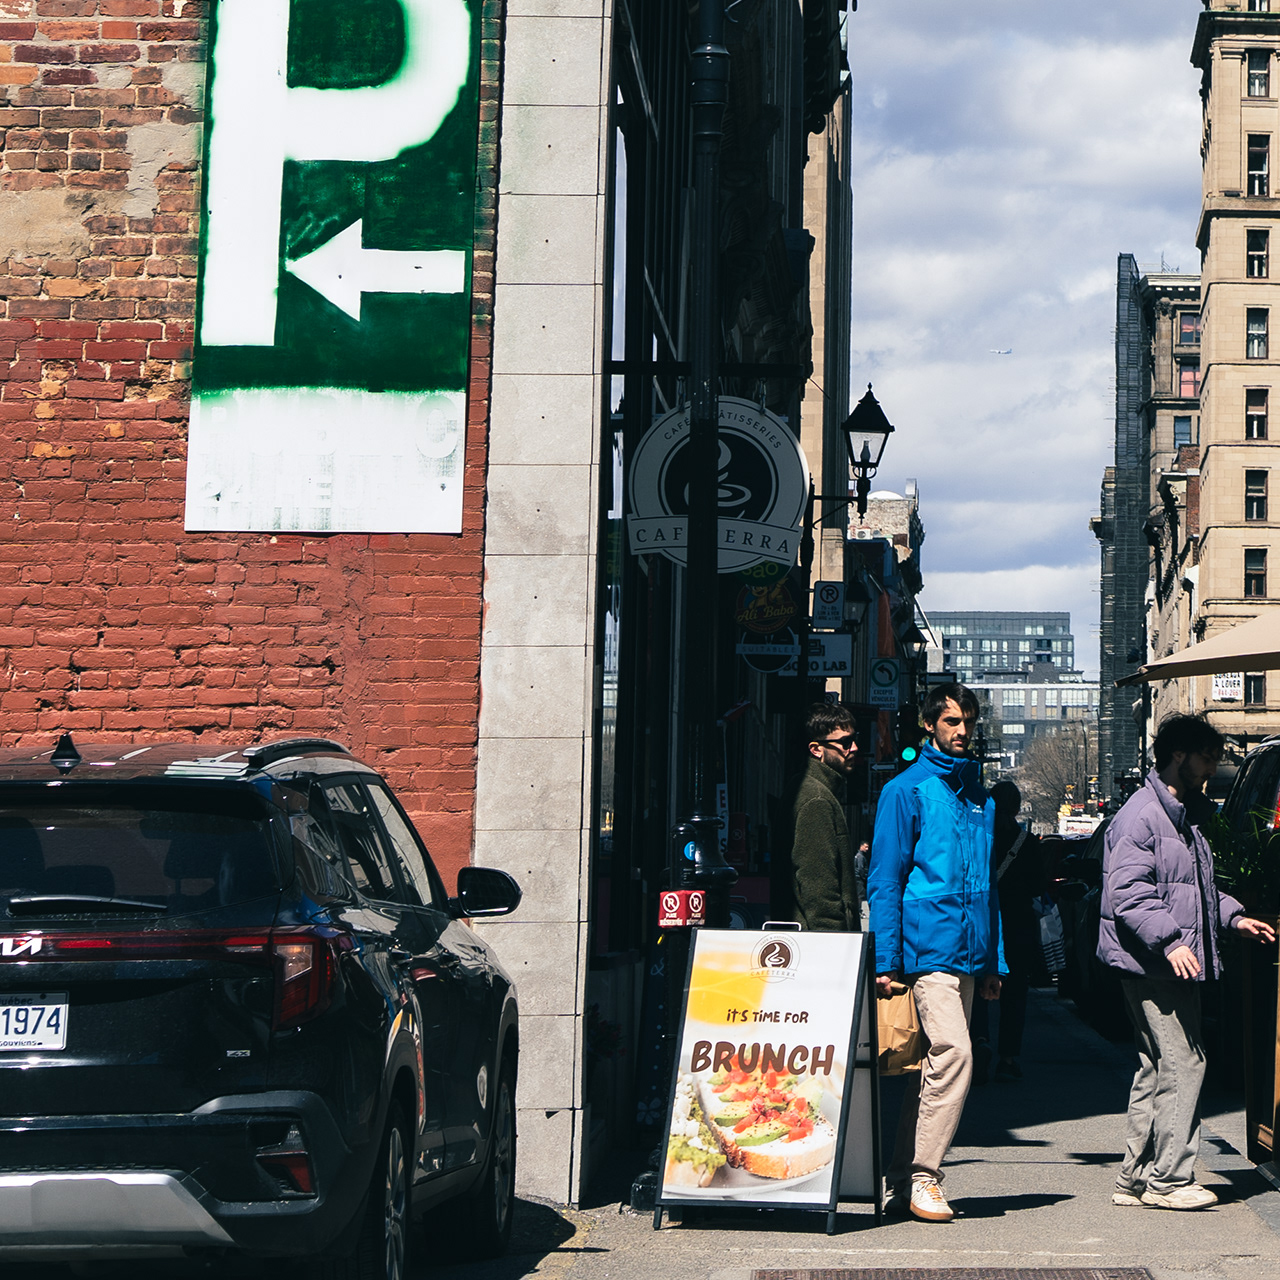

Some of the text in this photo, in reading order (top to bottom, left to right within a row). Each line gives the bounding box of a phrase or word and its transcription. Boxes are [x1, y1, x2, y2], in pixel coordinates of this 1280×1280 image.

[718, 409, 782, 449] ÂTISSERIES
[636, 526, 789, 554] CAFERRA
[823, 661, 848, 671] LAB
[0, 996, 33, 1005] uébec
[2, 1006, 62, 1036] 1974
[690, 1040, 835, 1076] BRUNCH
